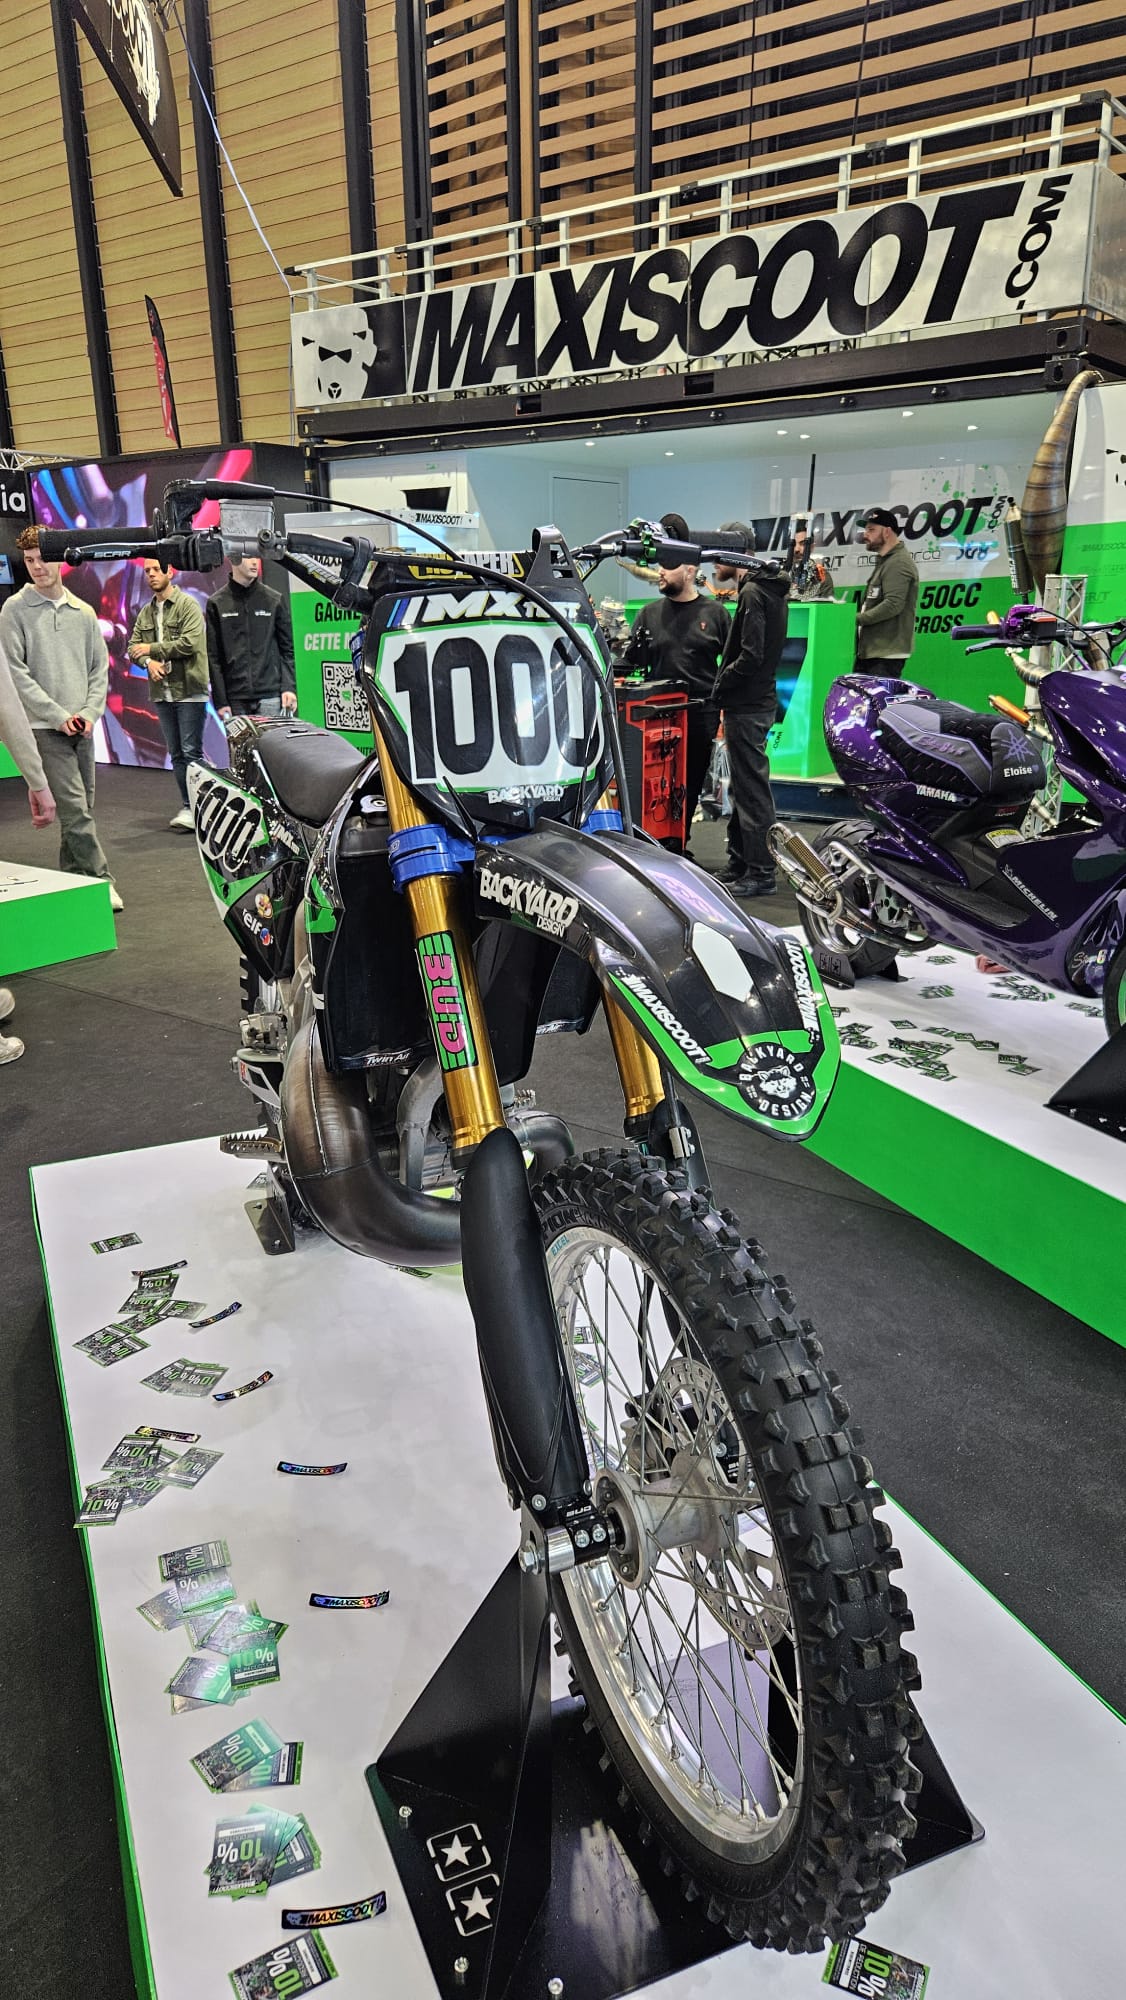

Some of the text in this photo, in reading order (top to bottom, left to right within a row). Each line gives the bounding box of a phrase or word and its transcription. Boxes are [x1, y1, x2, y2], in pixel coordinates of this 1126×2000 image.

[1005, 173, 1073, 311] .COM
[414, 181, 1026, 391] MAXISCOOT
[93, 550, 131, 559] SCAR
[920, 583, 982, 610] 50CC
[304, 633, 341, 652] CETTE
[394, 634, 600, 779] 1000
[915, 785, 957, 803] YAMAHA
[480, 867, 579, 928] BACKYARD
[1012, 876, 1058, 920] MICHELIN
[536, 915, 565, 938] DESIGN
[423, 953, 466, 1054] BUD
[634, 978, 704, 1062] MAXISCOOT
[367, 1055, 392, 1066] Twin
[739, 1045, 804, 1081] BACKYARD
[759, 1091, 815, 1117] DESIGN
[86, 1498, 120, 1512] 10%
[566, 1505, 592, 1518] BUD
[184, 1546, 207, 1571] 10%
[231, 1648, 274, 1668] 10%
[222, 1733, 256, 1772] 10%
[216, 1838, 264, 1865] 10%
[307, 1901, 376, 1923] MAXISCOOT
[266, 1947, 304, 2000] 10%
[857, 1951, 893, 1997] 10%
